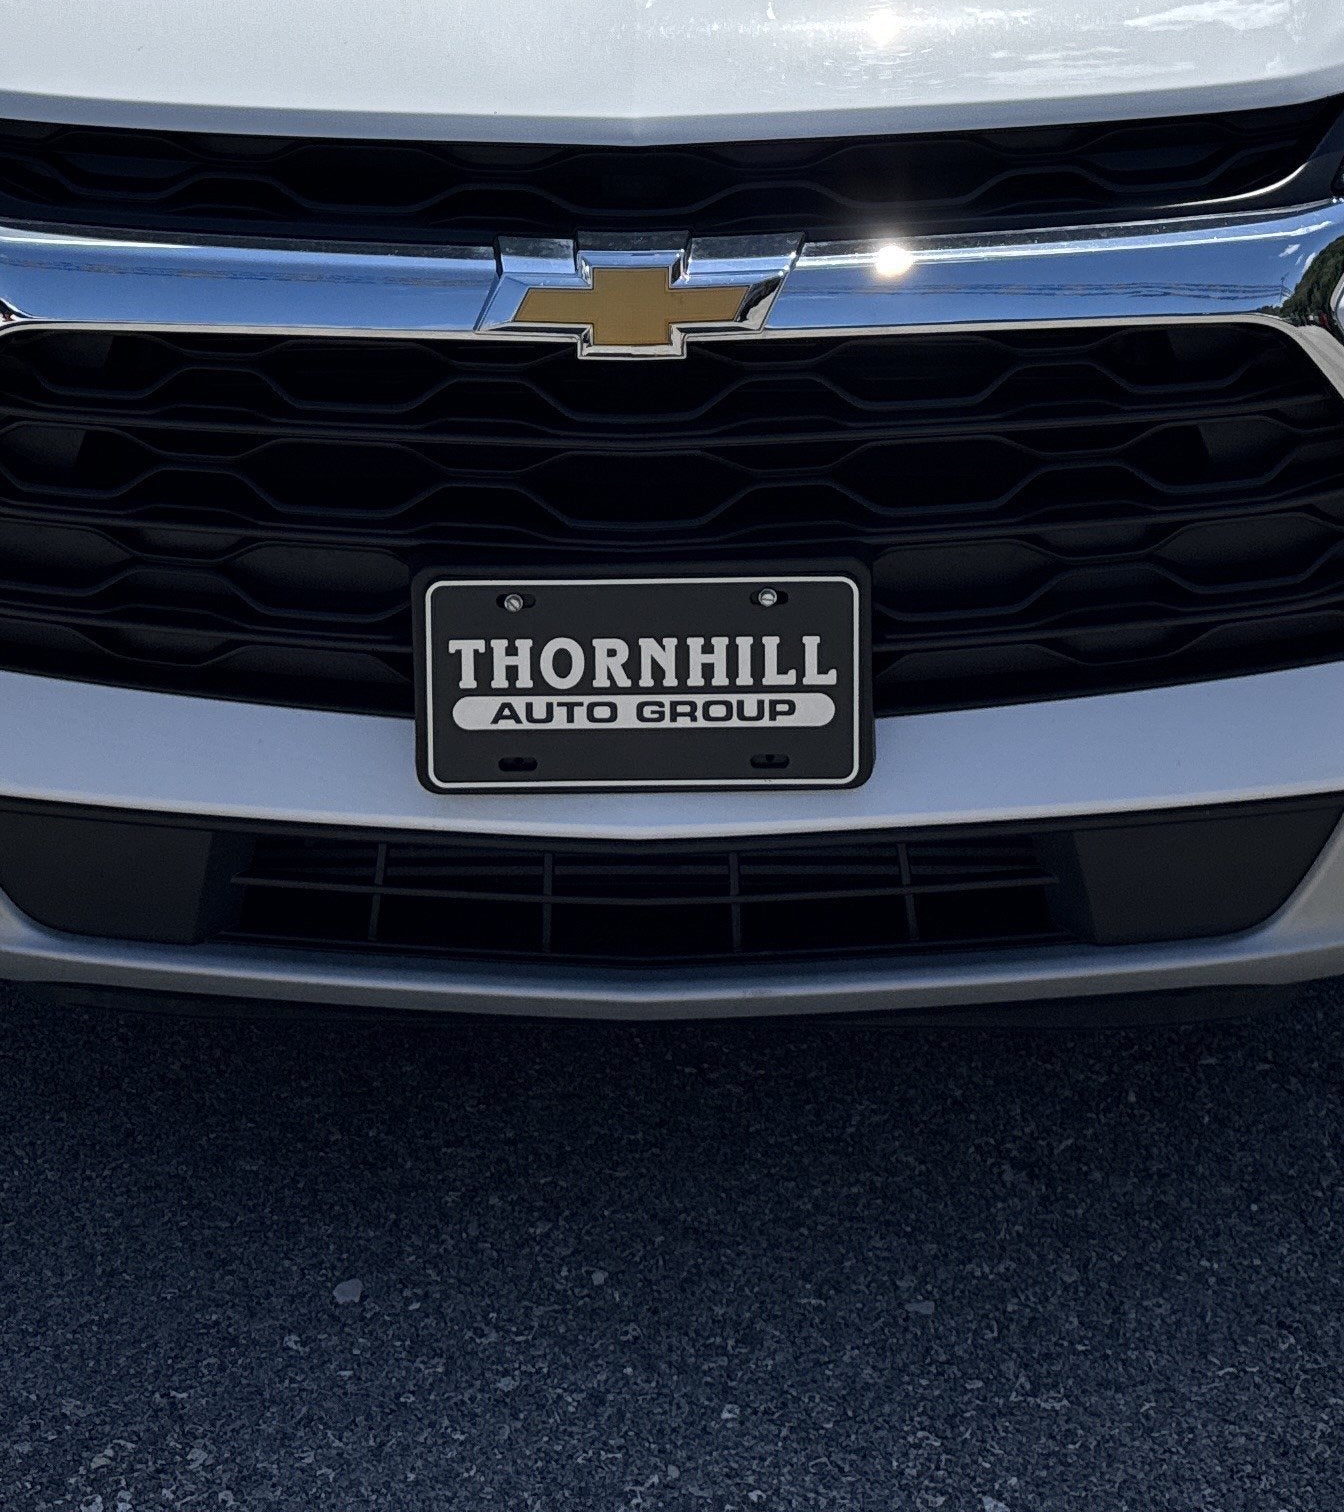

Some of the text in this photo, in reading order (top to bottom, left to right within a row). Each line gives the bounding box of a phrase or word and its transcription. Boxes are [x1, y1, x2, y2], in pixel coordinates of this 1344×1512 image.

[448, 635, 838, 689] THORNHILL
[489, 698, 797, 725] AUTO GROUP
